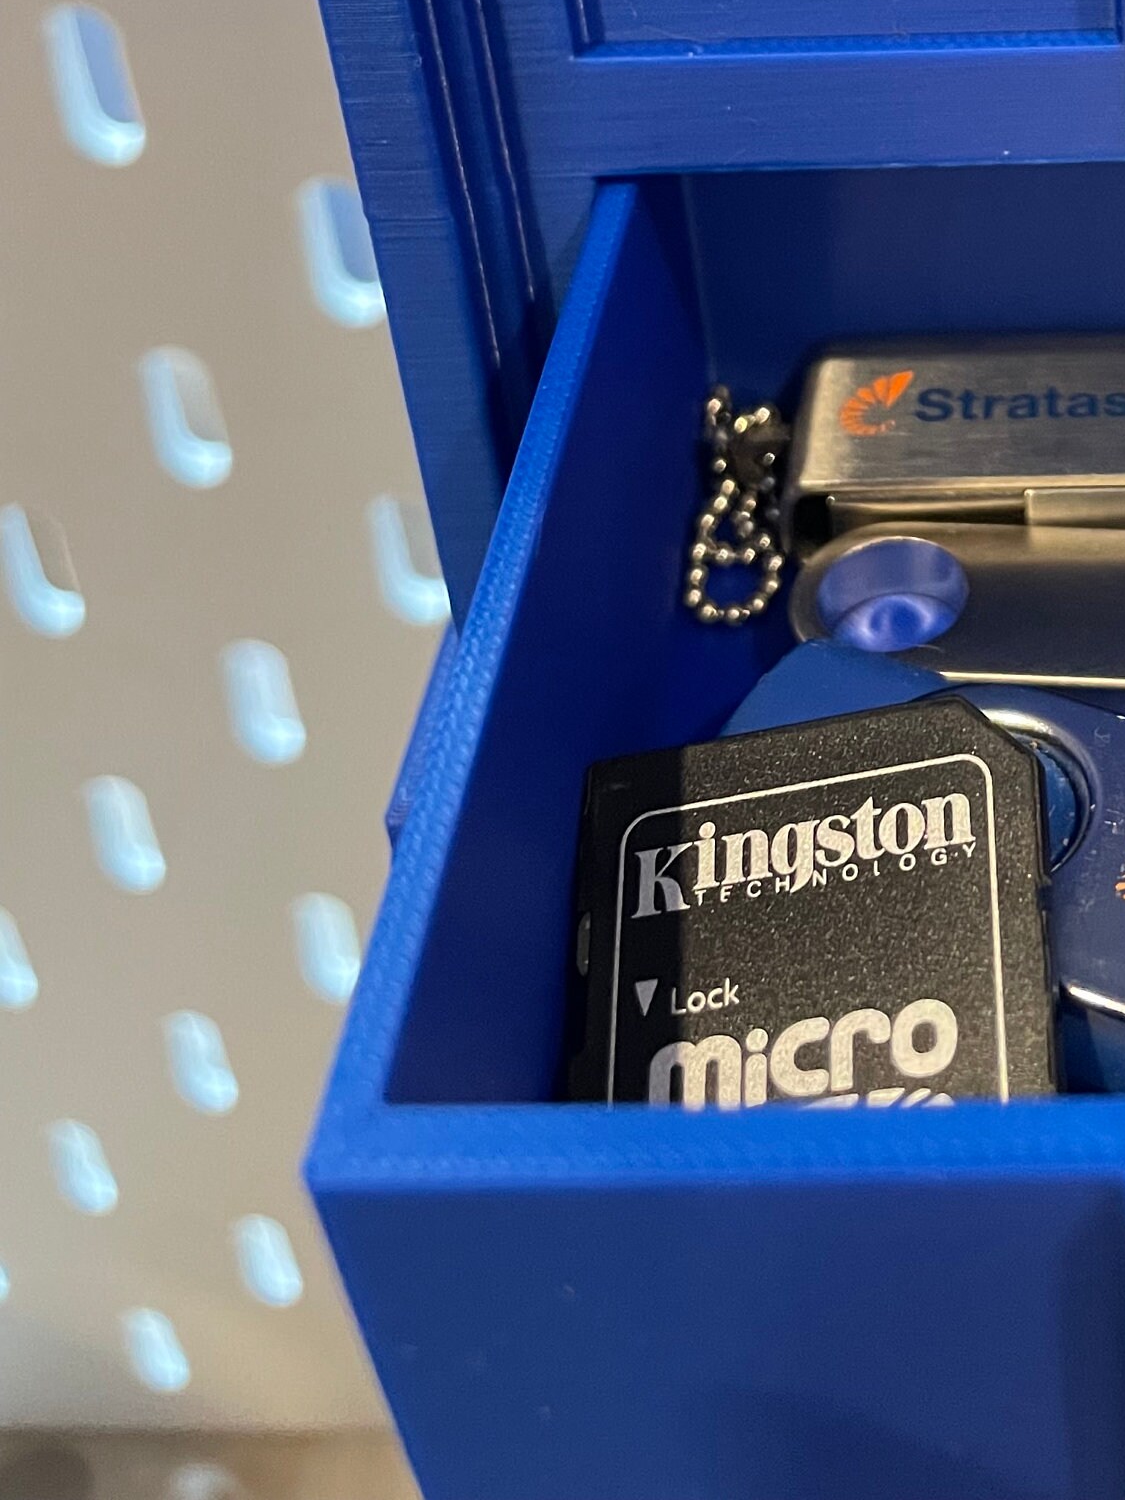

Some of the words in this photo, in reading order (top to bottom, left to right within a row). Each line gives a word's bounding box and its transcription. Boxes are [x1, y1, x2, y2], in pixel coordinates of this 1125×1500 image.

[631, 792, 976, 918] Kingston
[694, 842, 977, 907] TECHNOLOGY
[670, 976, 740, 1015] Lock
[648, 998, 959, 1111] micro
